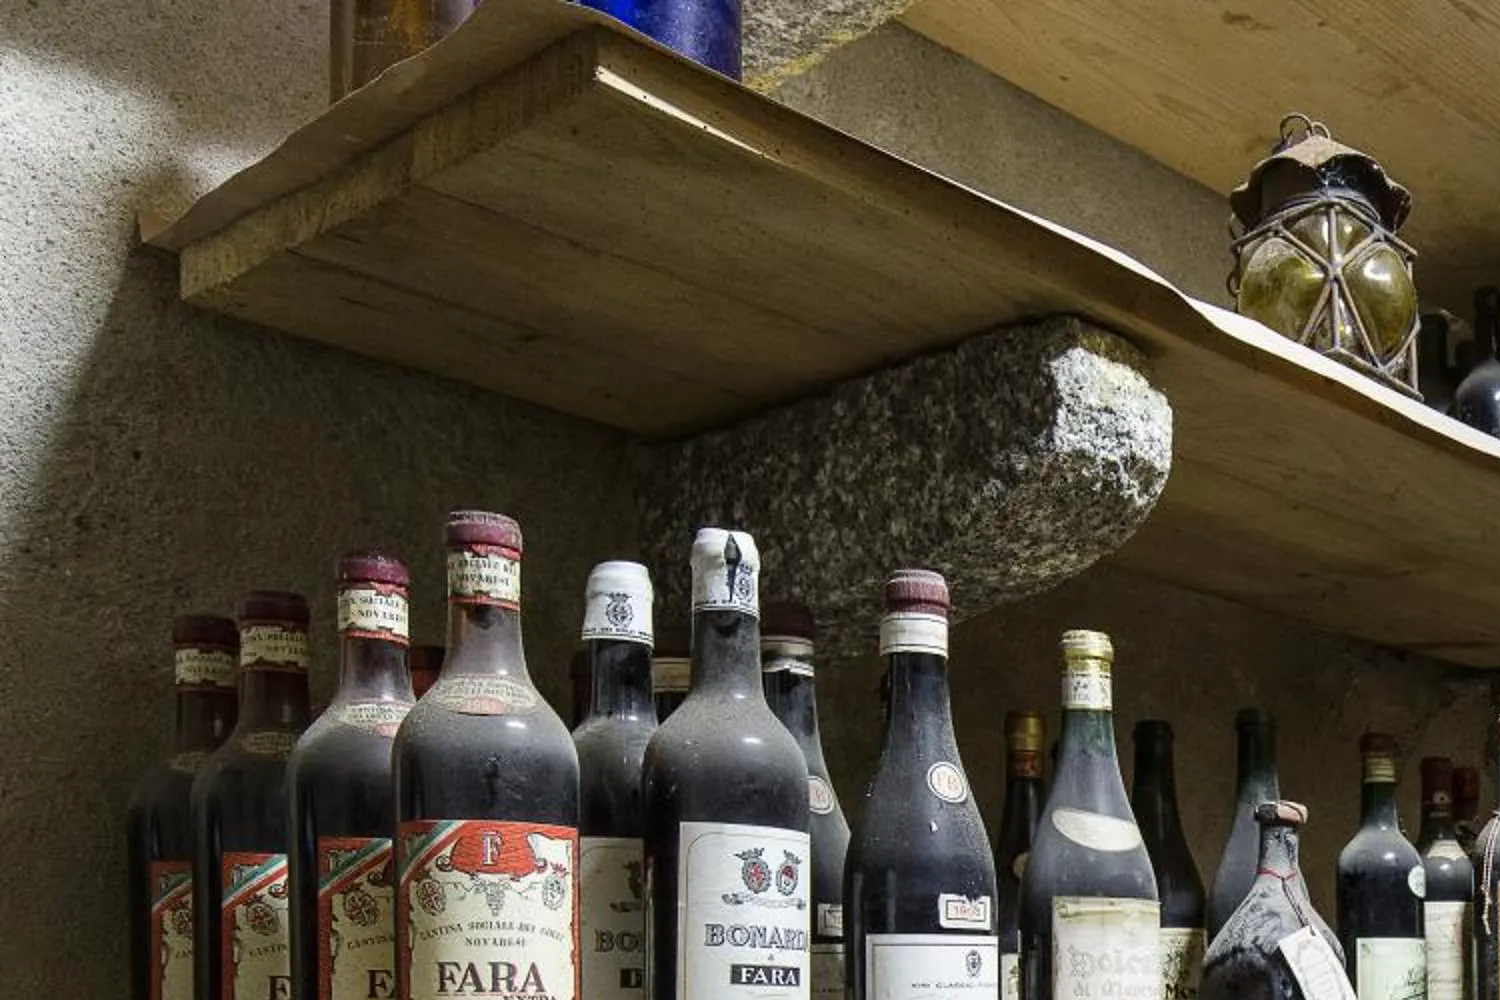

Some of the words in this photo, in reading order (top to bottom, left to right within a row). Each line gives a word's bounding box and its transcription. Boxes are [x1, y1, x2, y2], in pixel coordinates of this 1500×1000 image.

[467, 919, 515, 932] SOCIALE
[465, 937, 526, 949] NOVARESI
[436, 960, 547, 993] FARA
[740, 967, 798, 986] FARA
